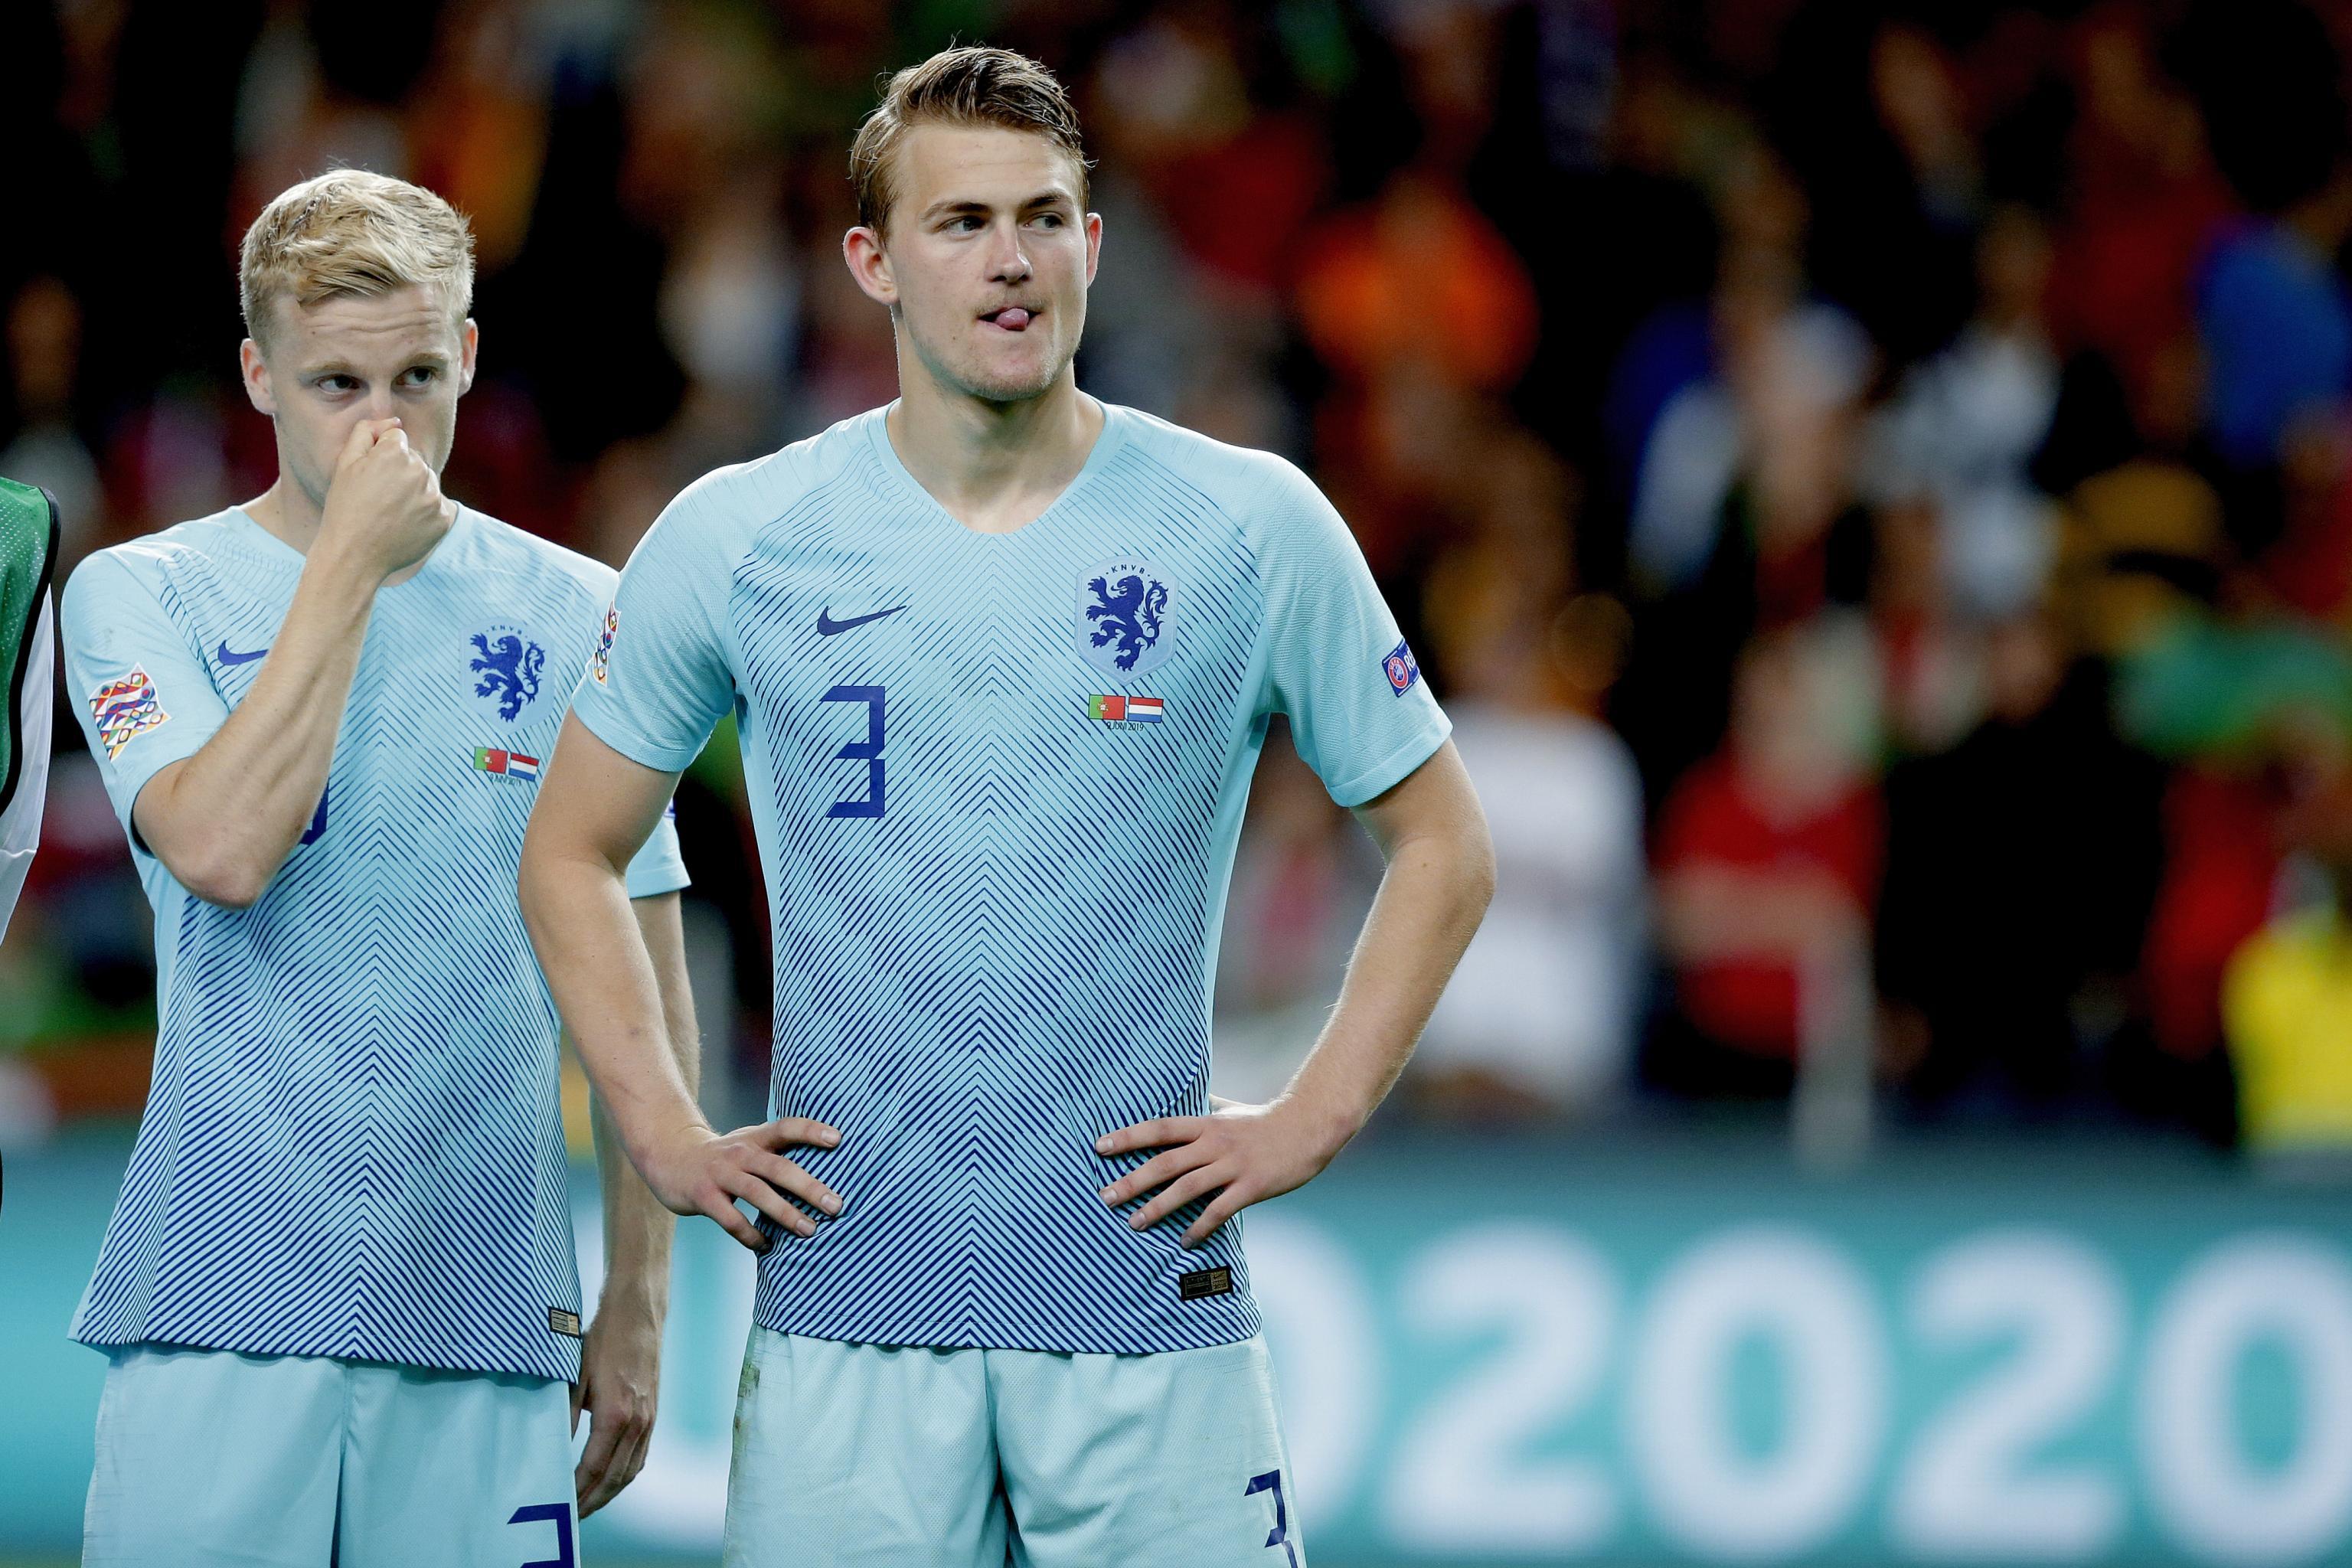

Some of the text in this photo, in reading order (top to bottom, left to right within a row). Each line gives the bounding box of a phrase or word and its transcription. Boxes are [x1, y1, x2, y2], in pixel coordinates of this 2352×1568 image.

[1111, 564, 1145, 574] KNVB
[1128, 722, 1145, 731] 2019
[819, 686, 885, 818] 3
